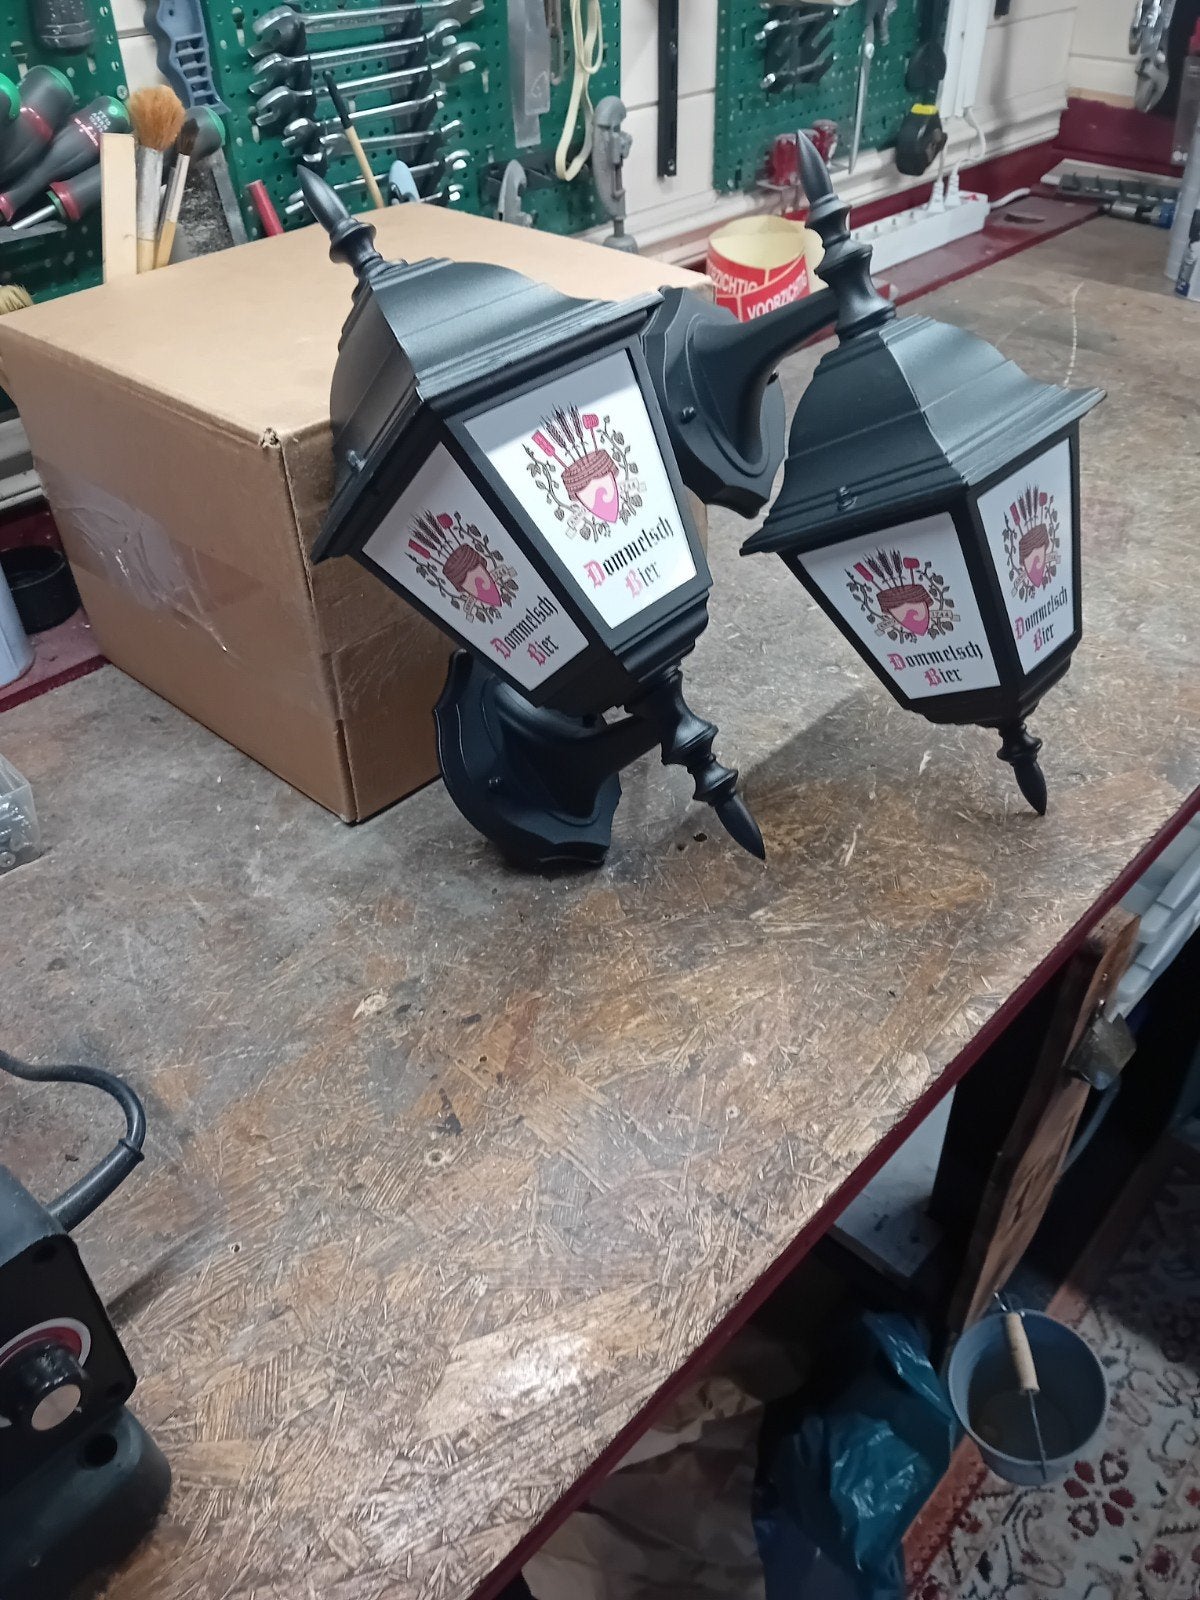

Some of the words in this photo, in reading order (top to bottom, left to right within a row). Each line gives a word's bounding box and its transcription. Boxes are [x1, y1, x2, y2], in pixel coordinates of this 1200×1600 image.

[625, 562, 661, 598] Bier
[490, 595, 558, 660] Dommelsch
[1015, 586, 1068, 640] Dommelsch
[527, 635, 559, 666] Bier
[1033, 624, 1054, 652] Bier
[887, 641, 983, 671] Dommelsch
[924, 668, 962, 688] Bier
